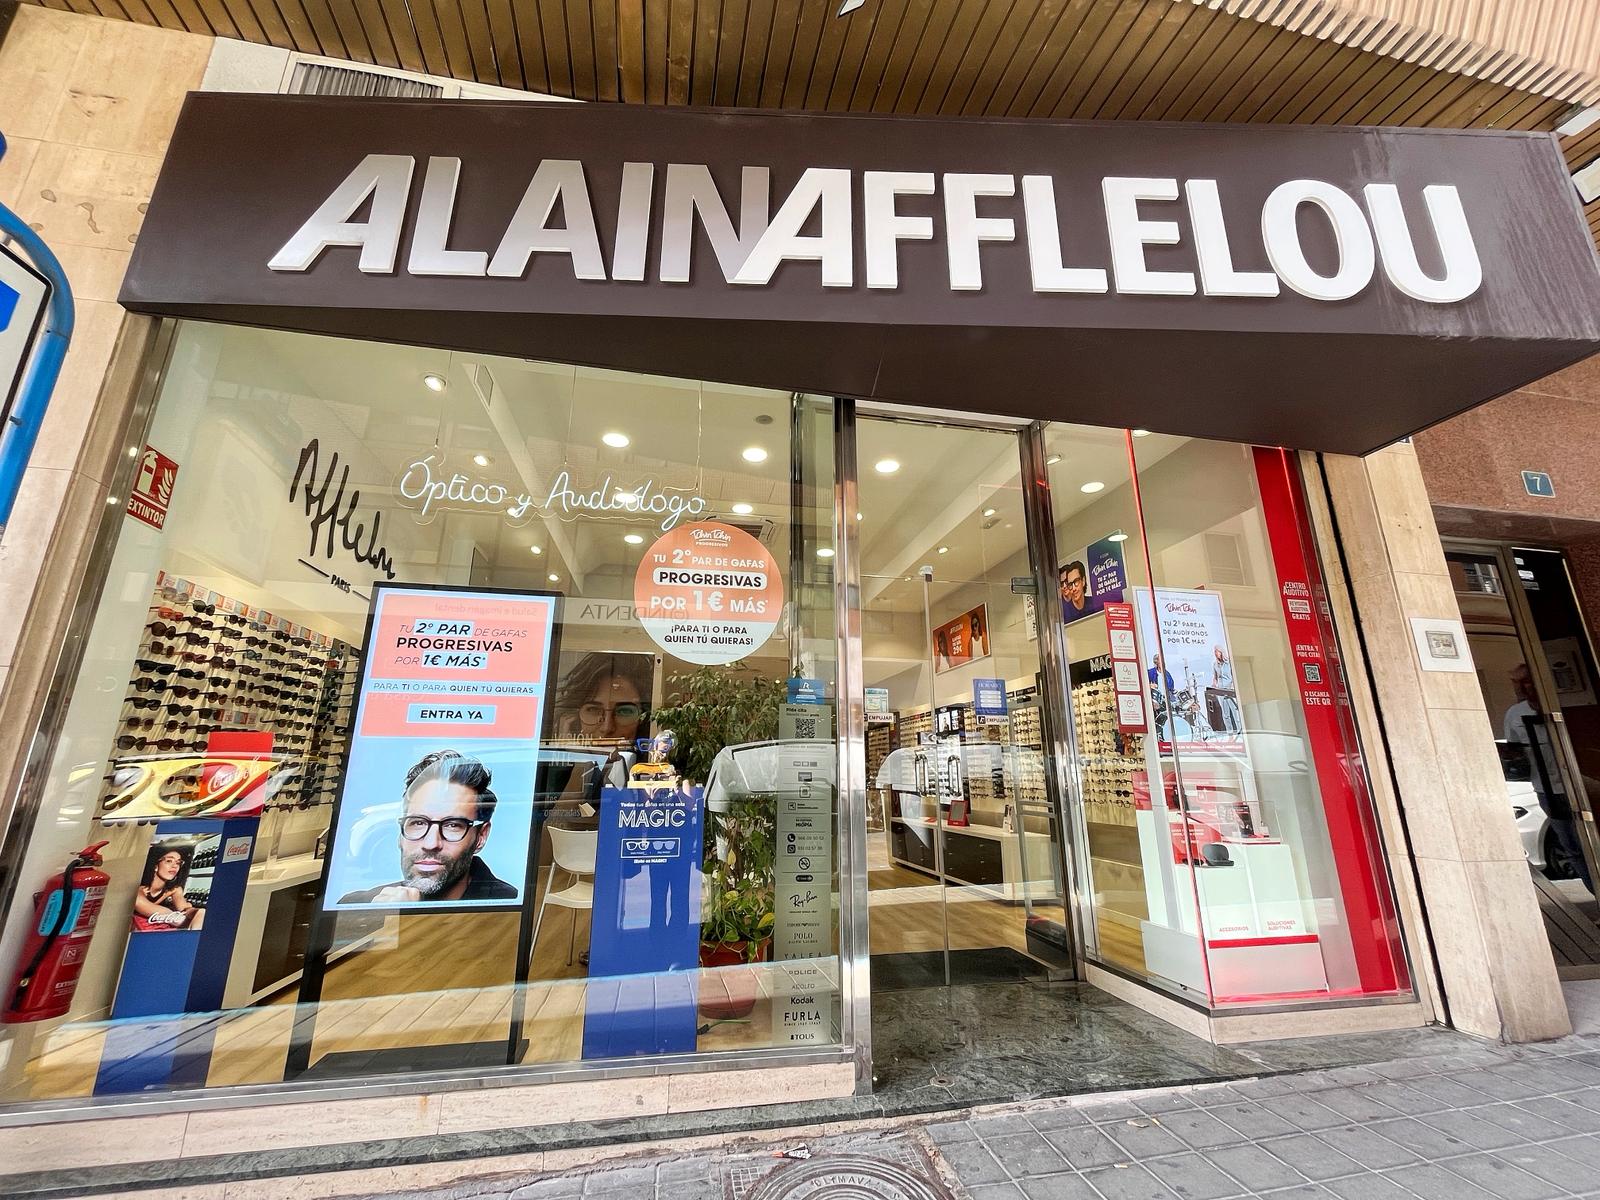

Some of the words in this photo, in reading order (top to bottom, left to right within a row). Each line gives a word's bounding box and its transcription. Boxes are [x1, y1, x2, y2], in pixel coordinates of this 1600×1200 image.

[1528, 472, 1541, 492] 7
[400, 455, 507, 516] Óptico
[512, 491, 532, 518] y
[545, 471, 706, 531] Audiólogo
[127, 498, 165, 526] EXTINTOR
[653, 554, 667, 563] TU
[692, 556, 712, 566] PAR
[715, 558, 728, 567] DE
[730, 559, 765, 569] GAFAS
[331, 574, 351, 594] PARIS
[659, 571, 762, 588] PROGRESIVAS
[650, 596, 686, 610] POR
[399, 625, 414, 634] TU
[437, 623, 471, 636] PAR
[474, 628, 489, 637] DE
[491, 629, 528, 638] GAFAS
[671, 624, 699, 634] ¡PARA
[702, 625, 710, 633] TI
[712, 626, 720, 634] O
[723, 626, 748, 635] PARA
[396, 637, 513, 652] PROGRESIVAS
[664, 635, 695, 644] QUIEN
[696, 634, 708, 644] TÚ
[710, 636, 754, 646] QUIERAS!
[394, 656, 420, 665] POR
[423, 654, 442, 666] 1€
[374, 682, 399, 690] PARA
[450, 685, 478, 693] QUIEN
[481, 684, 493, 693] TÚ
[1306, 698, 1320, 706] ESTE
[420, 709, 463, 720] ENTRA
[467, 710, 483, 720] YA
[618, 809, 686, 828] MAGIC
[794, 932, 813, 940] POLO
[790, 996, 814, 1005] Kodak
[784, 1010, 821, 1022] FURLA
[795, 1033, 815, 1041] TOUS
